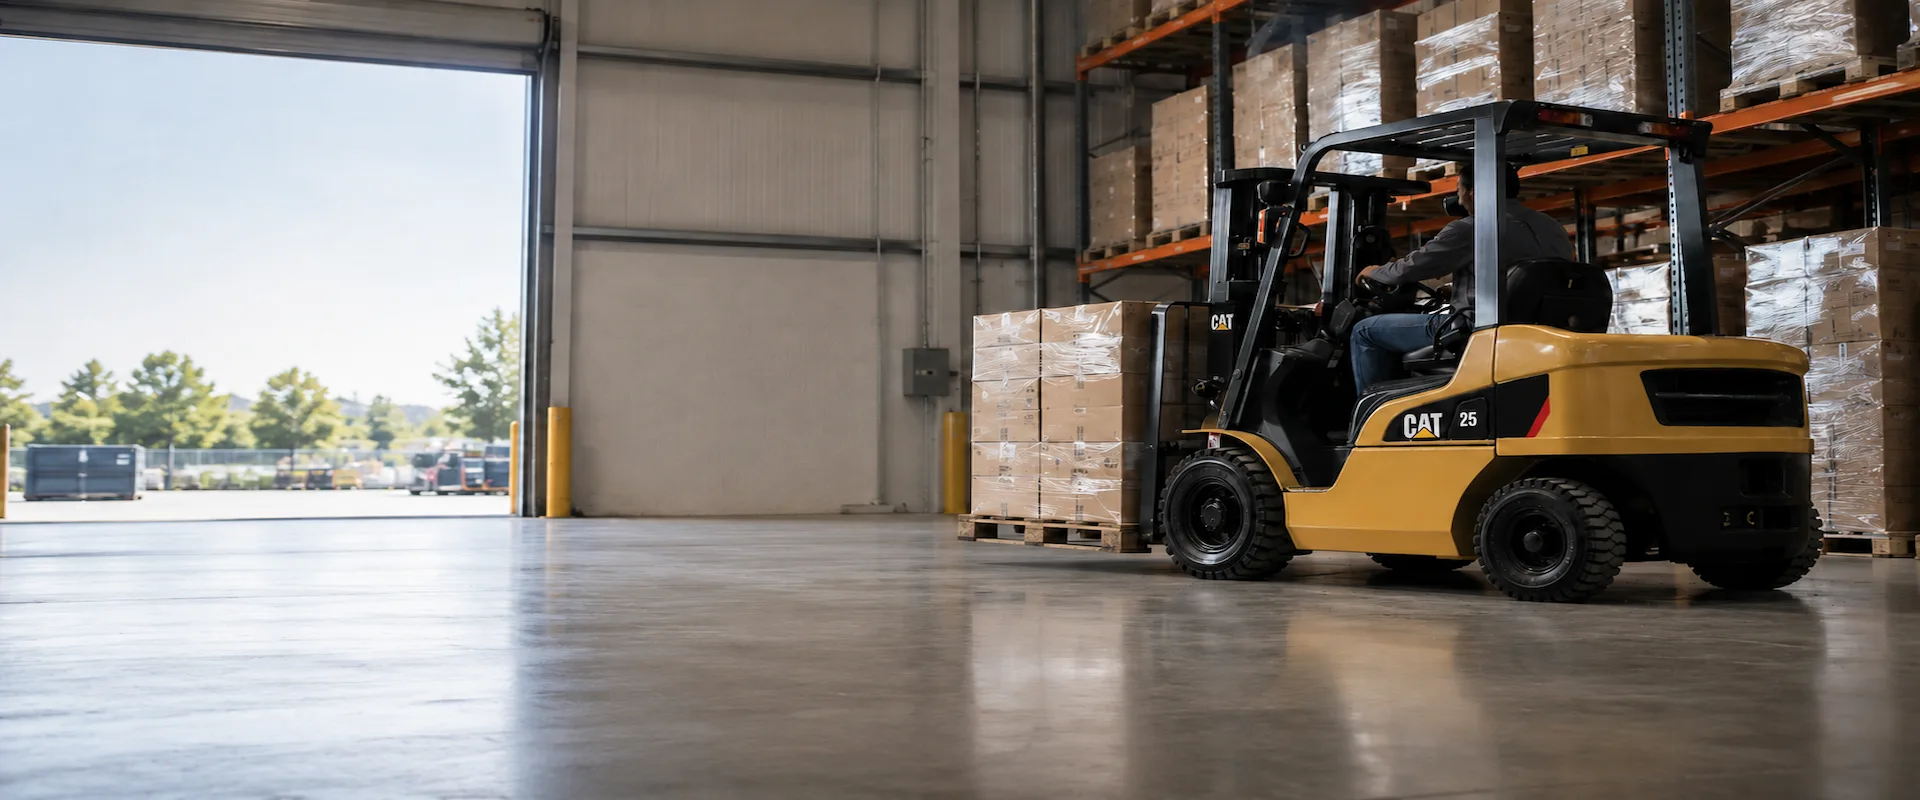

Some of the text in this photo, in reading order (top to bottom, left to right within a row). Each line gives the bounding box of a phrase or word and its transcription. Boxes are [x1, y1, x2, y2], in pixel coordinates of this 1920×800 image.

[1211, 313, 1234, 330] CAT
[1404, 412, 1443, 439] CAT
[1460, 411, 1478, 427] 25
